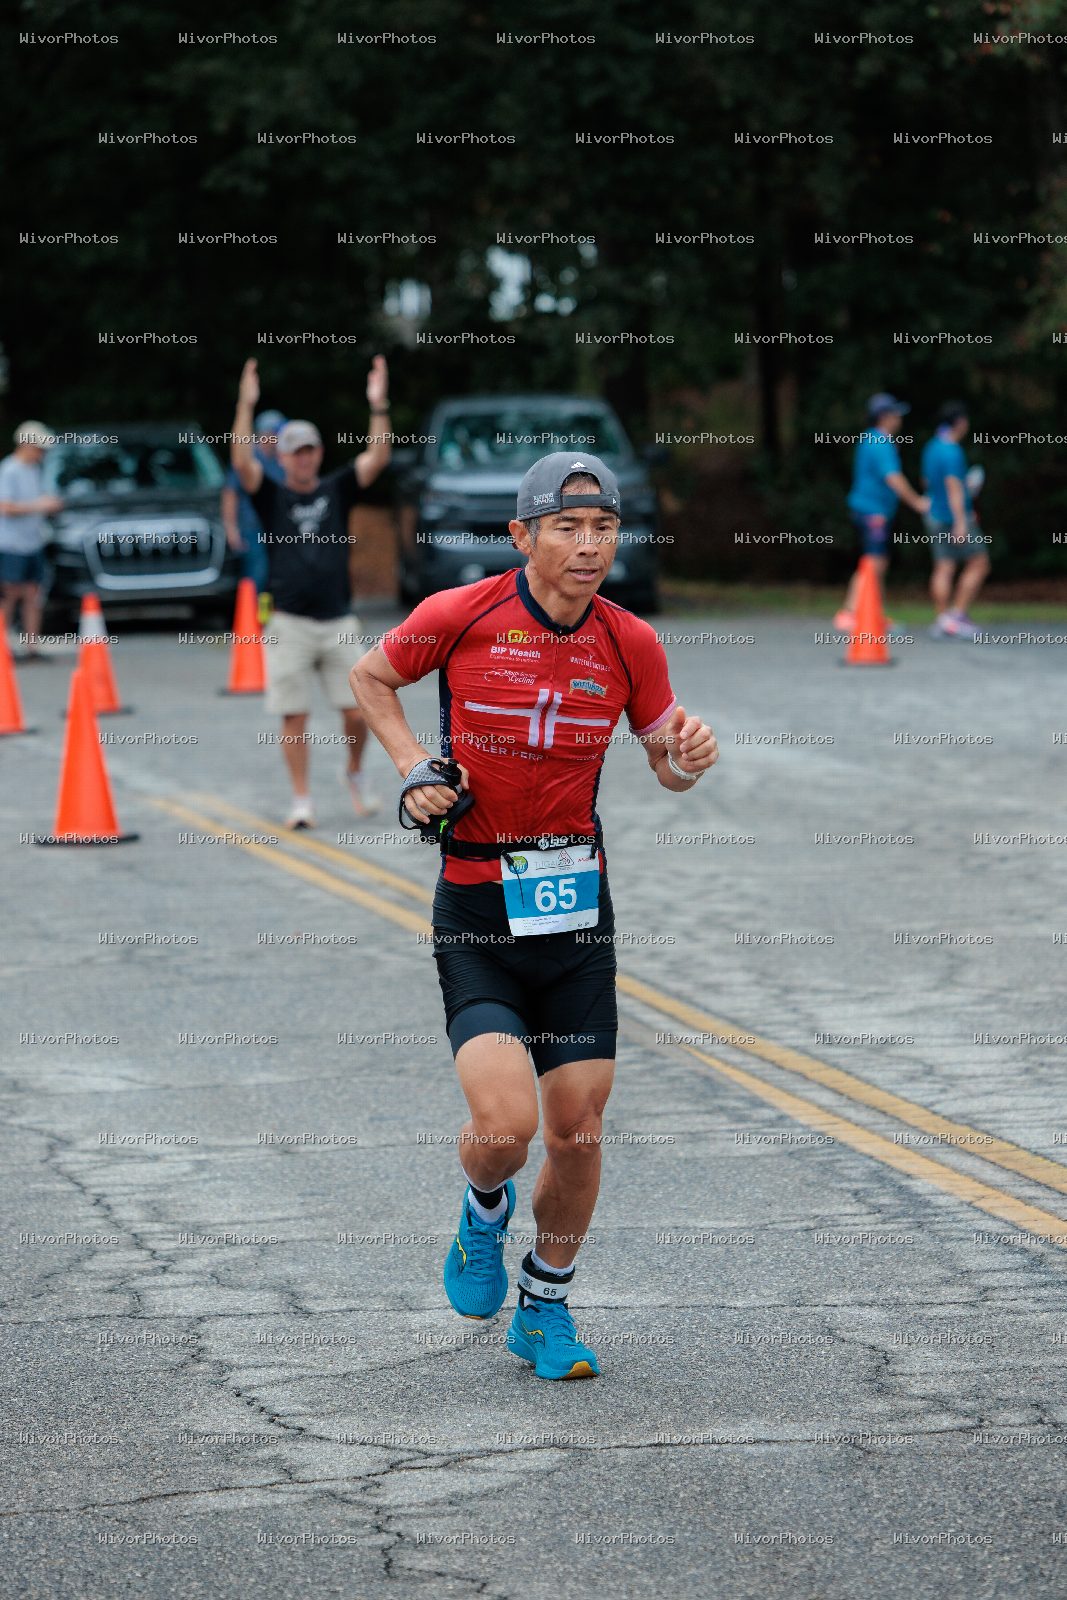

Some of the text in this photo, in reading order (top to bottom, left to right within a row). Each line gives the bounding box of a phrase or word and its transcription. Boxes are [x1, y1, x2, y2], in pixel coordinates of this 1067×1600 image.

[490, 646, 507, 655] BIP
[509, 648, 541, 659] Wealth
[510, 675, 535, 686] Cycling
[535, 877, 578, 913] 65
[543, 1287, 558, 1297] 65
